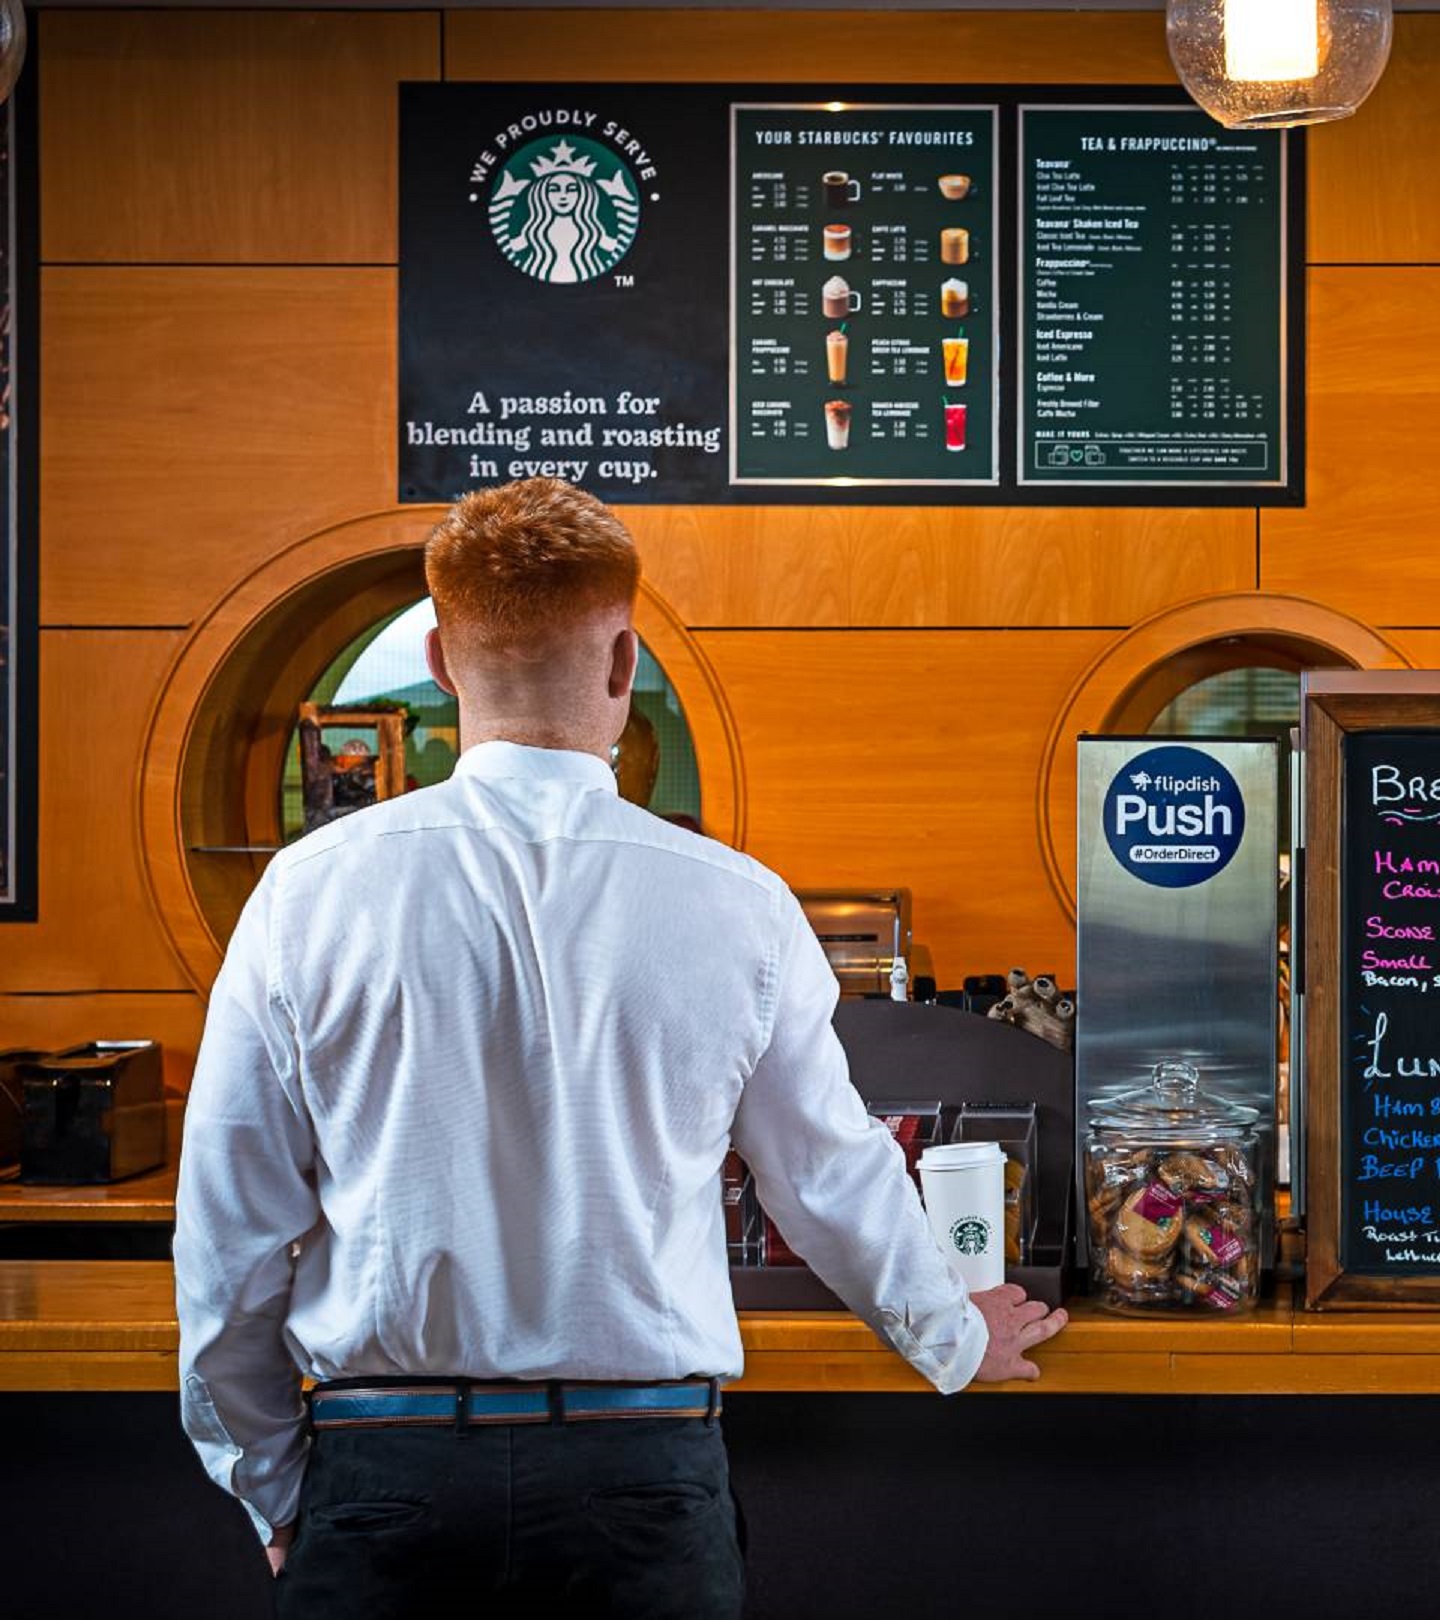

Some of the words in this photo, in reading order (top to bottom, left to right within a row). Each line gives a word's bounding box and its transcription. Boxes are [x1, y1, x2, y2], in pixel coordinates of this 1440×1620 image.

[469, 150, 497, 183] WE
[495, 109, 598, 150] PROUDLY
[602, 121, 658, 182] SERVE
[755, 131, 792, 145] YOUR
[889, 131, 974, 145] FAVOURITES
[1081, 137, 1104, 151] TEA
[1107, 137, 1116, 151] &
[1105, 218, 1123, 228] Iced
[1124, 218, 1139, 228] Tea
[614, 275, 635, 288] TM
[1036, 329, 1053, 339] Iced
[1036, 372, 1064, 382] Coffee
[1073, 372, 1095, 382] More
[467, 393, 491, 415] A
[500, 391, 607, 424] passion
[616, 391, 660, 415] for
[406, 421, 531, 453] blending
[541, 421, 593, 446] and
[602, 425, 721, 453] roasting
[469, 455, 498, 478] in
[508, 460, 588, 482] every
[598, 460, 658, 483] cup.
[1154, 775, 1221, 796] flipdish
[1116, 794, 1233, 836] Push
[1134, 848, 1216, 860] #OrderDirect
[1430, 1096, 1440, 1116] &
[1362, 1225, 1418, 1243] Roast
